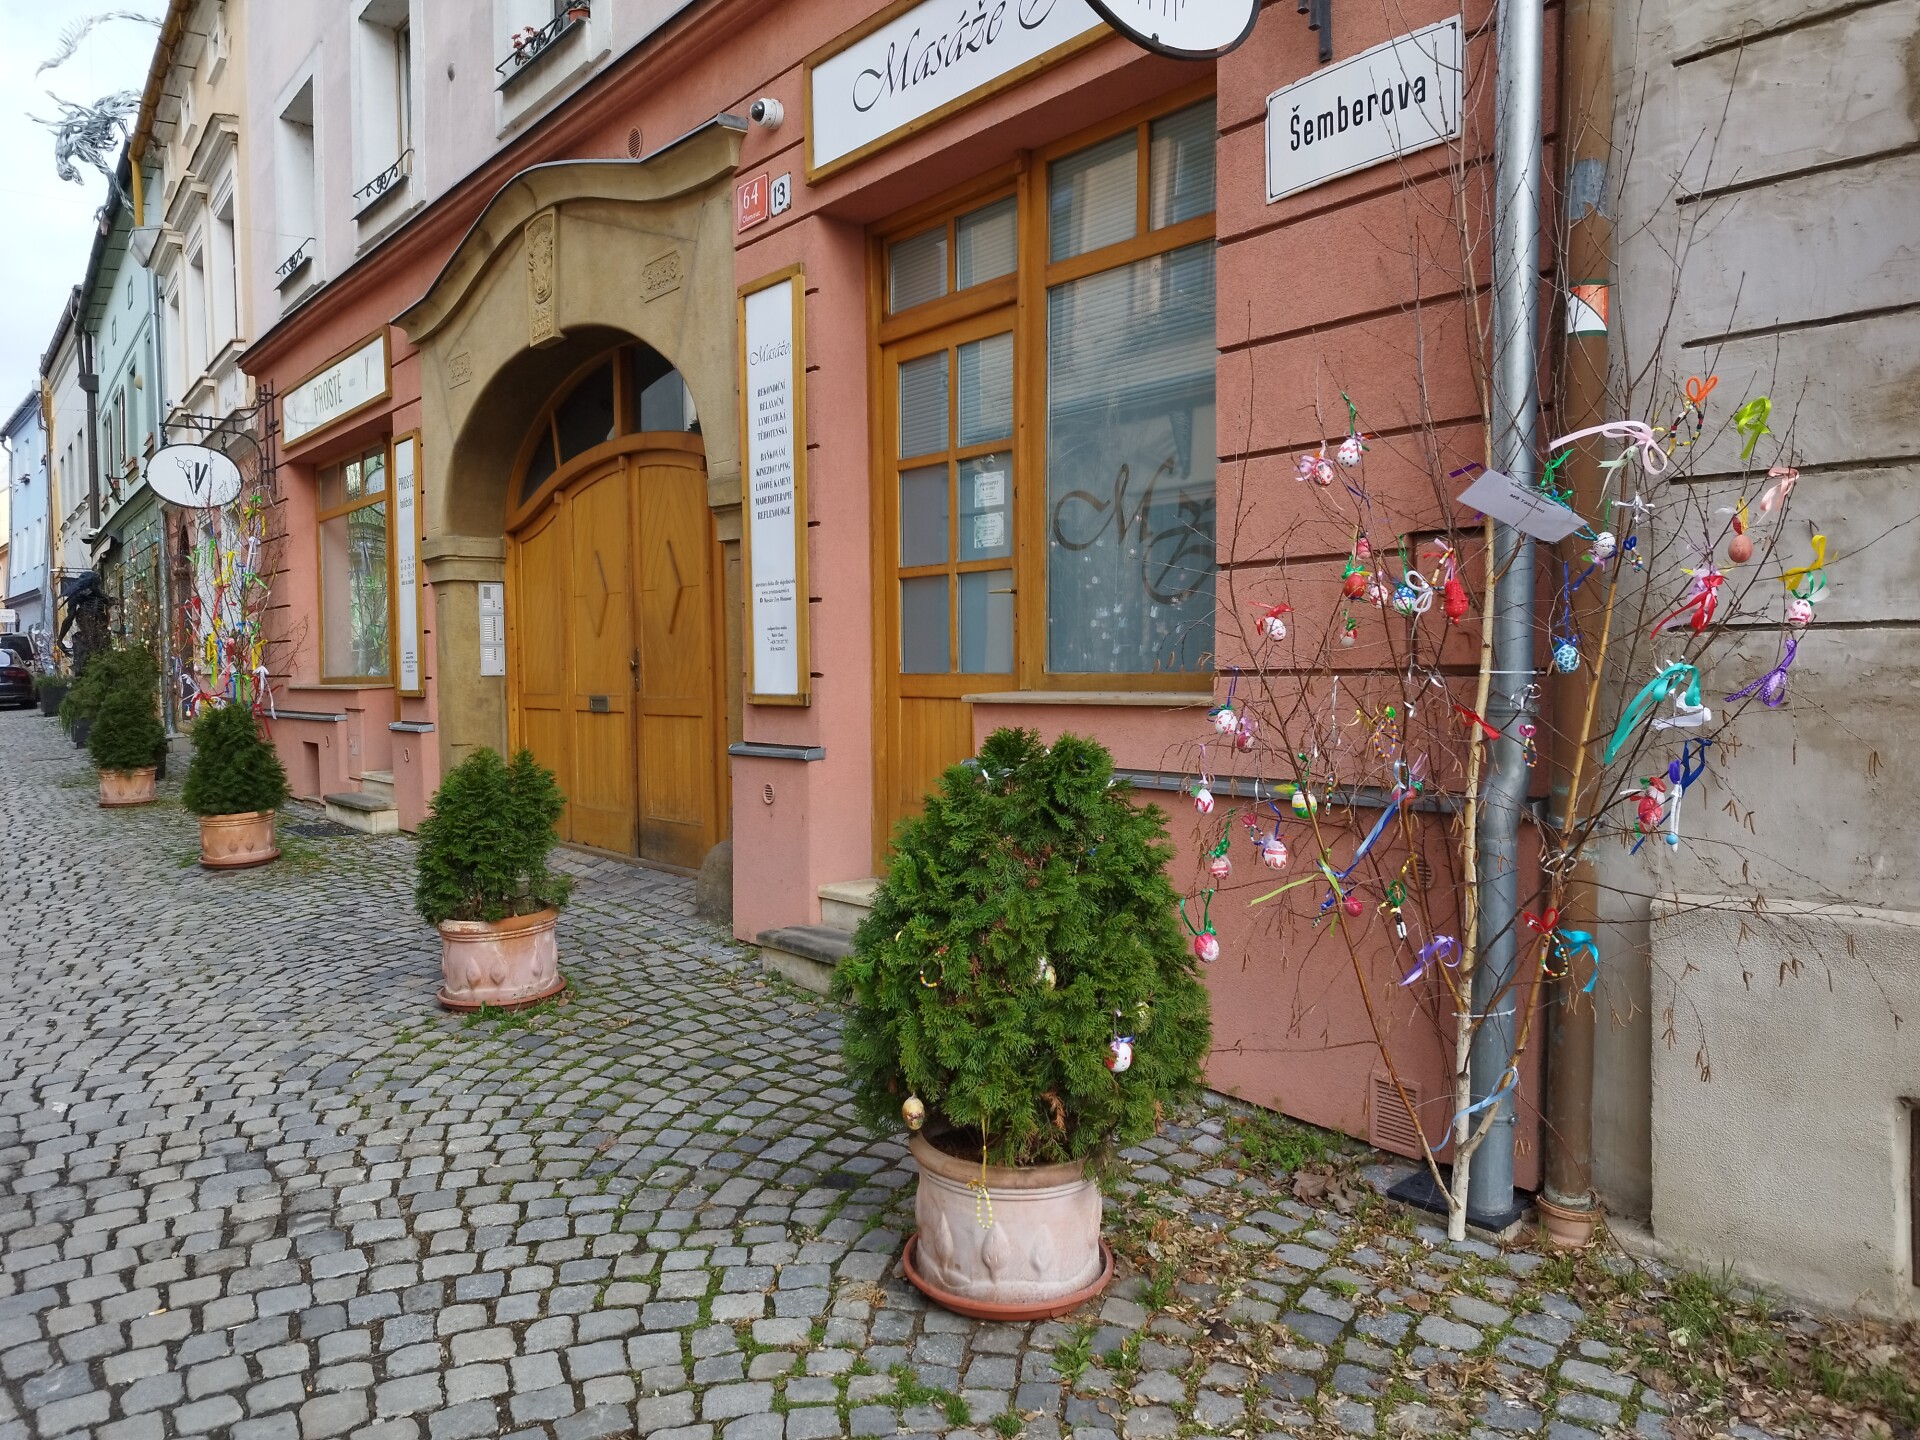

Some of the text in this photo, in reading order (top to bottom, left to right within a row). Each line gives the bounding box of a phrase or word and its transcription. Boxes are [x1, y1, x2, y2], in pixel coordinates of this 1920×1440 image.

[852, 0, 1006, 113] Masáže
[1290, 75, 1427, 151] Šemberova
[743, 182, 759, 210] 64
[773, 182, 786, 208] 13
[313, 369, 343, 416] PROSTĚ
[757, 379, 786, 398] REKONDIČNÍ
[759, 395, 784, 412] RELAXAČNÍ
[758, 409, 786, 427] LYMFATICKÁ
[757, 423, 788, 441] TĚHOTENSKÁ
[755, 491, 793, 506] MADEROTERAPIE
[757, 506, 791, 520] REFLEXOLOGIE
